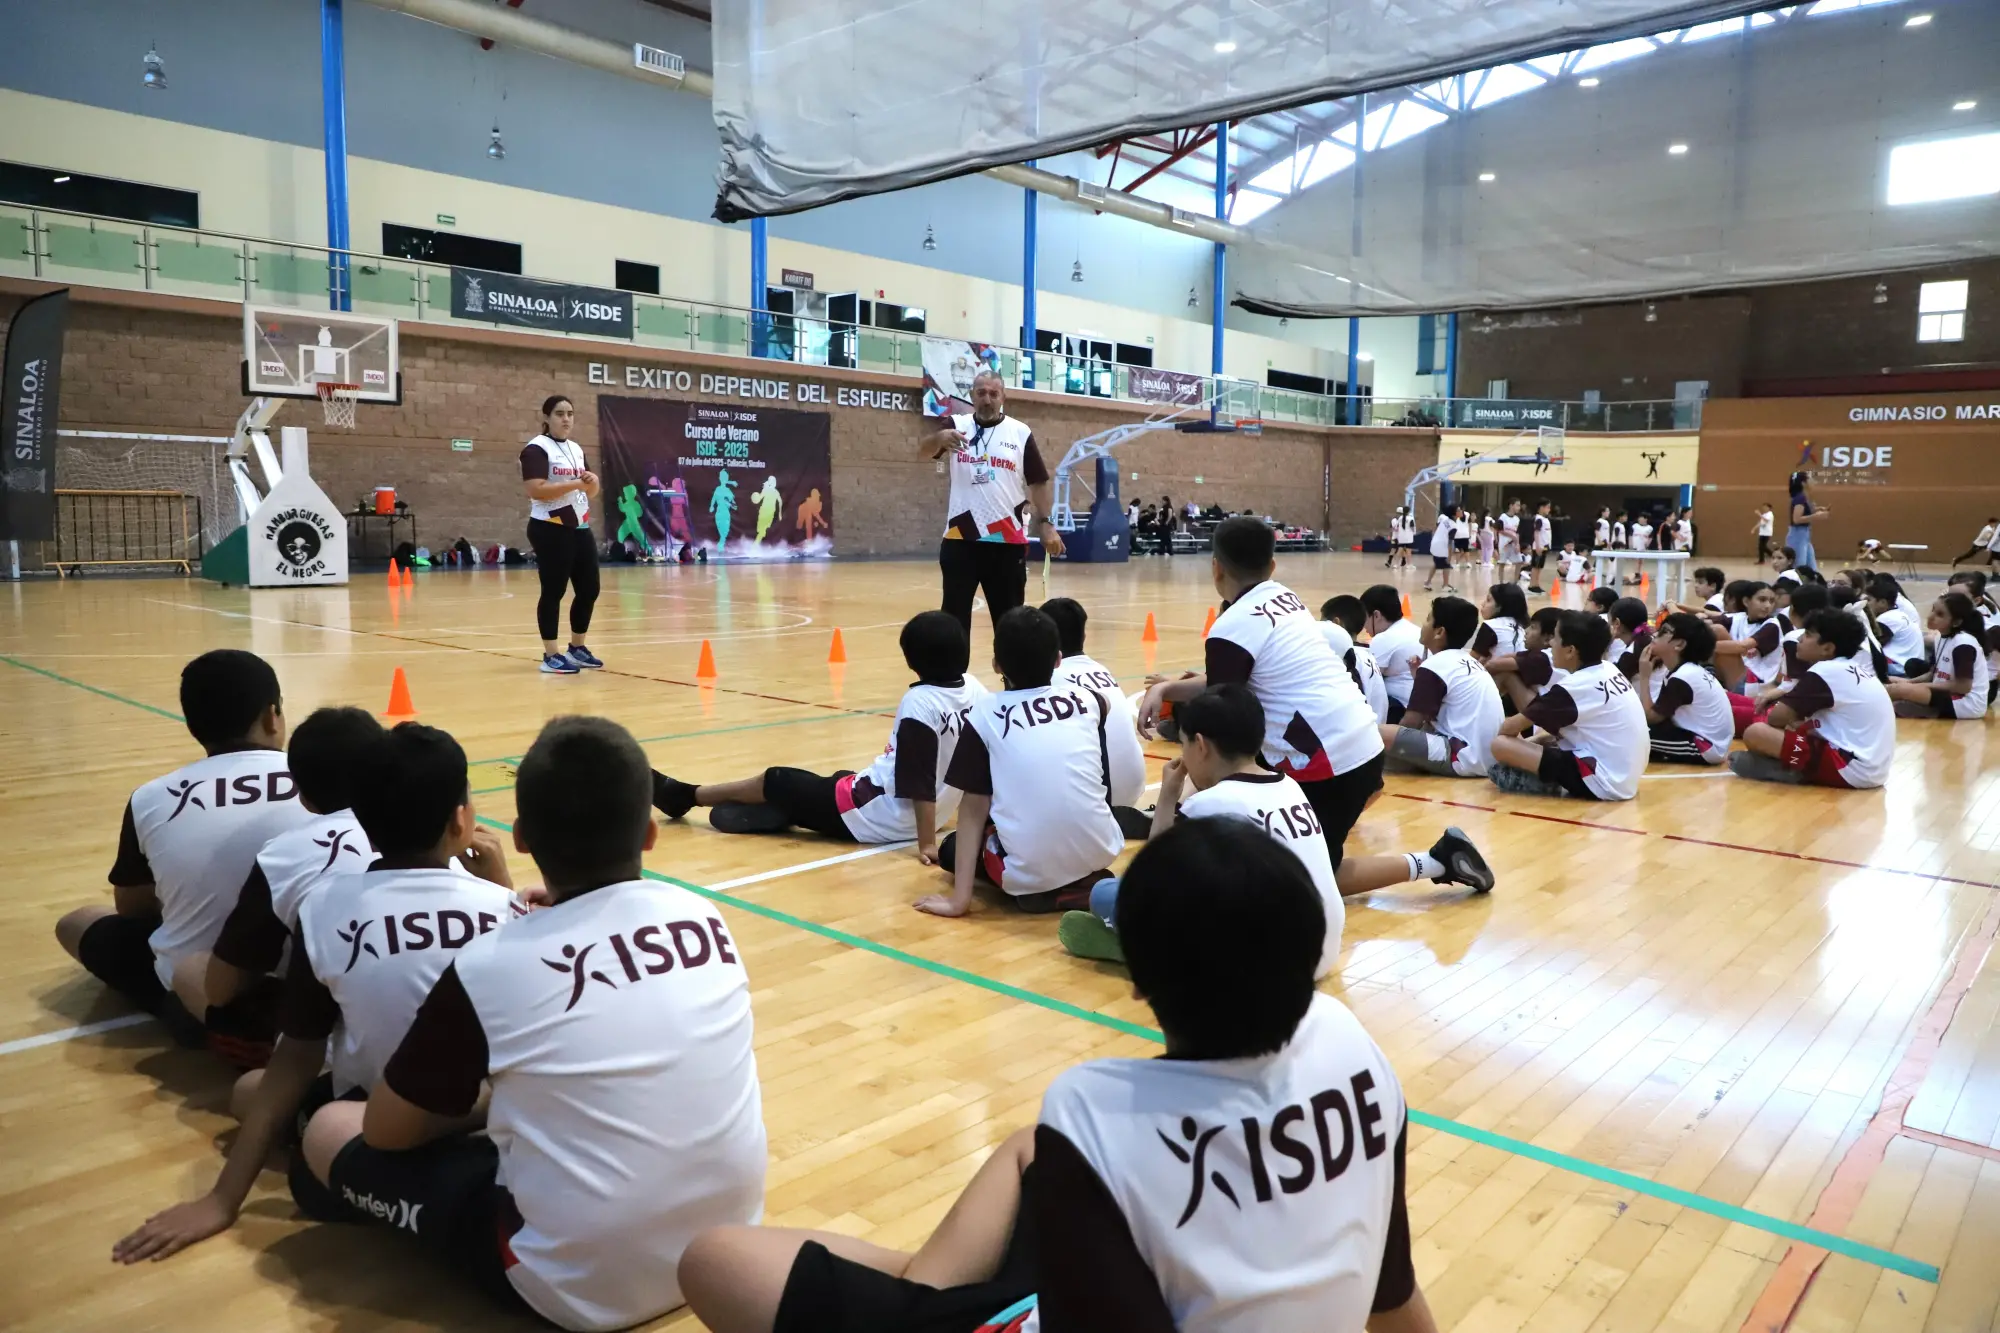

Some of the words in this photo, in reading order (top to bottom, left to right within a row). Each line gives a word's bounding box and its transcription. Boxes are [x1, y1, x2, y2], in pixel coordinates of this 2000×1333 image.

[488, 291, 558, 313] SINALOA
[585, 303, 622, 321] ISDE
[588, 362, 616, 385] EL
[625, 366, 692, 391] EXITO
[700, 373, 790, 401] DEPENDE
[797, 383, 831, 404] DEL
[837, 387, 916, 413] ESFUERZ
[1142, 379, 1170, 391] SINALOA
[15, 359, 40, 460] SINALOA
[698, 409, 729, 418] SINALOA
[740, 413, 757, 422] ISDE
[1475, 409, 1514, 418] SINALOA
[1529, 409, 1553, 419] ISDE
[1849, 406, 1947, 422] GIMNASIO
[685, 422, 714, 440] Curso
[714, 424, 727, 440] de
[727, 424, 760, 442] Verano
[696, 440, 717, 456] ISDE
[724, 441, 749, 458] 2025
[1822, 446, 1892, 468] ISDE
[276, 561, 289, 576] EL
[292, 560, 326, 578] NEGRO
[1270, 592, 1306, 614] ISD
[1086, 671, 1119, 689] ISD
[215, 771, 300, 808] ISD
[1278, 802, 1322, 840] ISD
[608, 916, 737, 983] ISDE
[1240, 1068, 1387, 1203] ISDE
